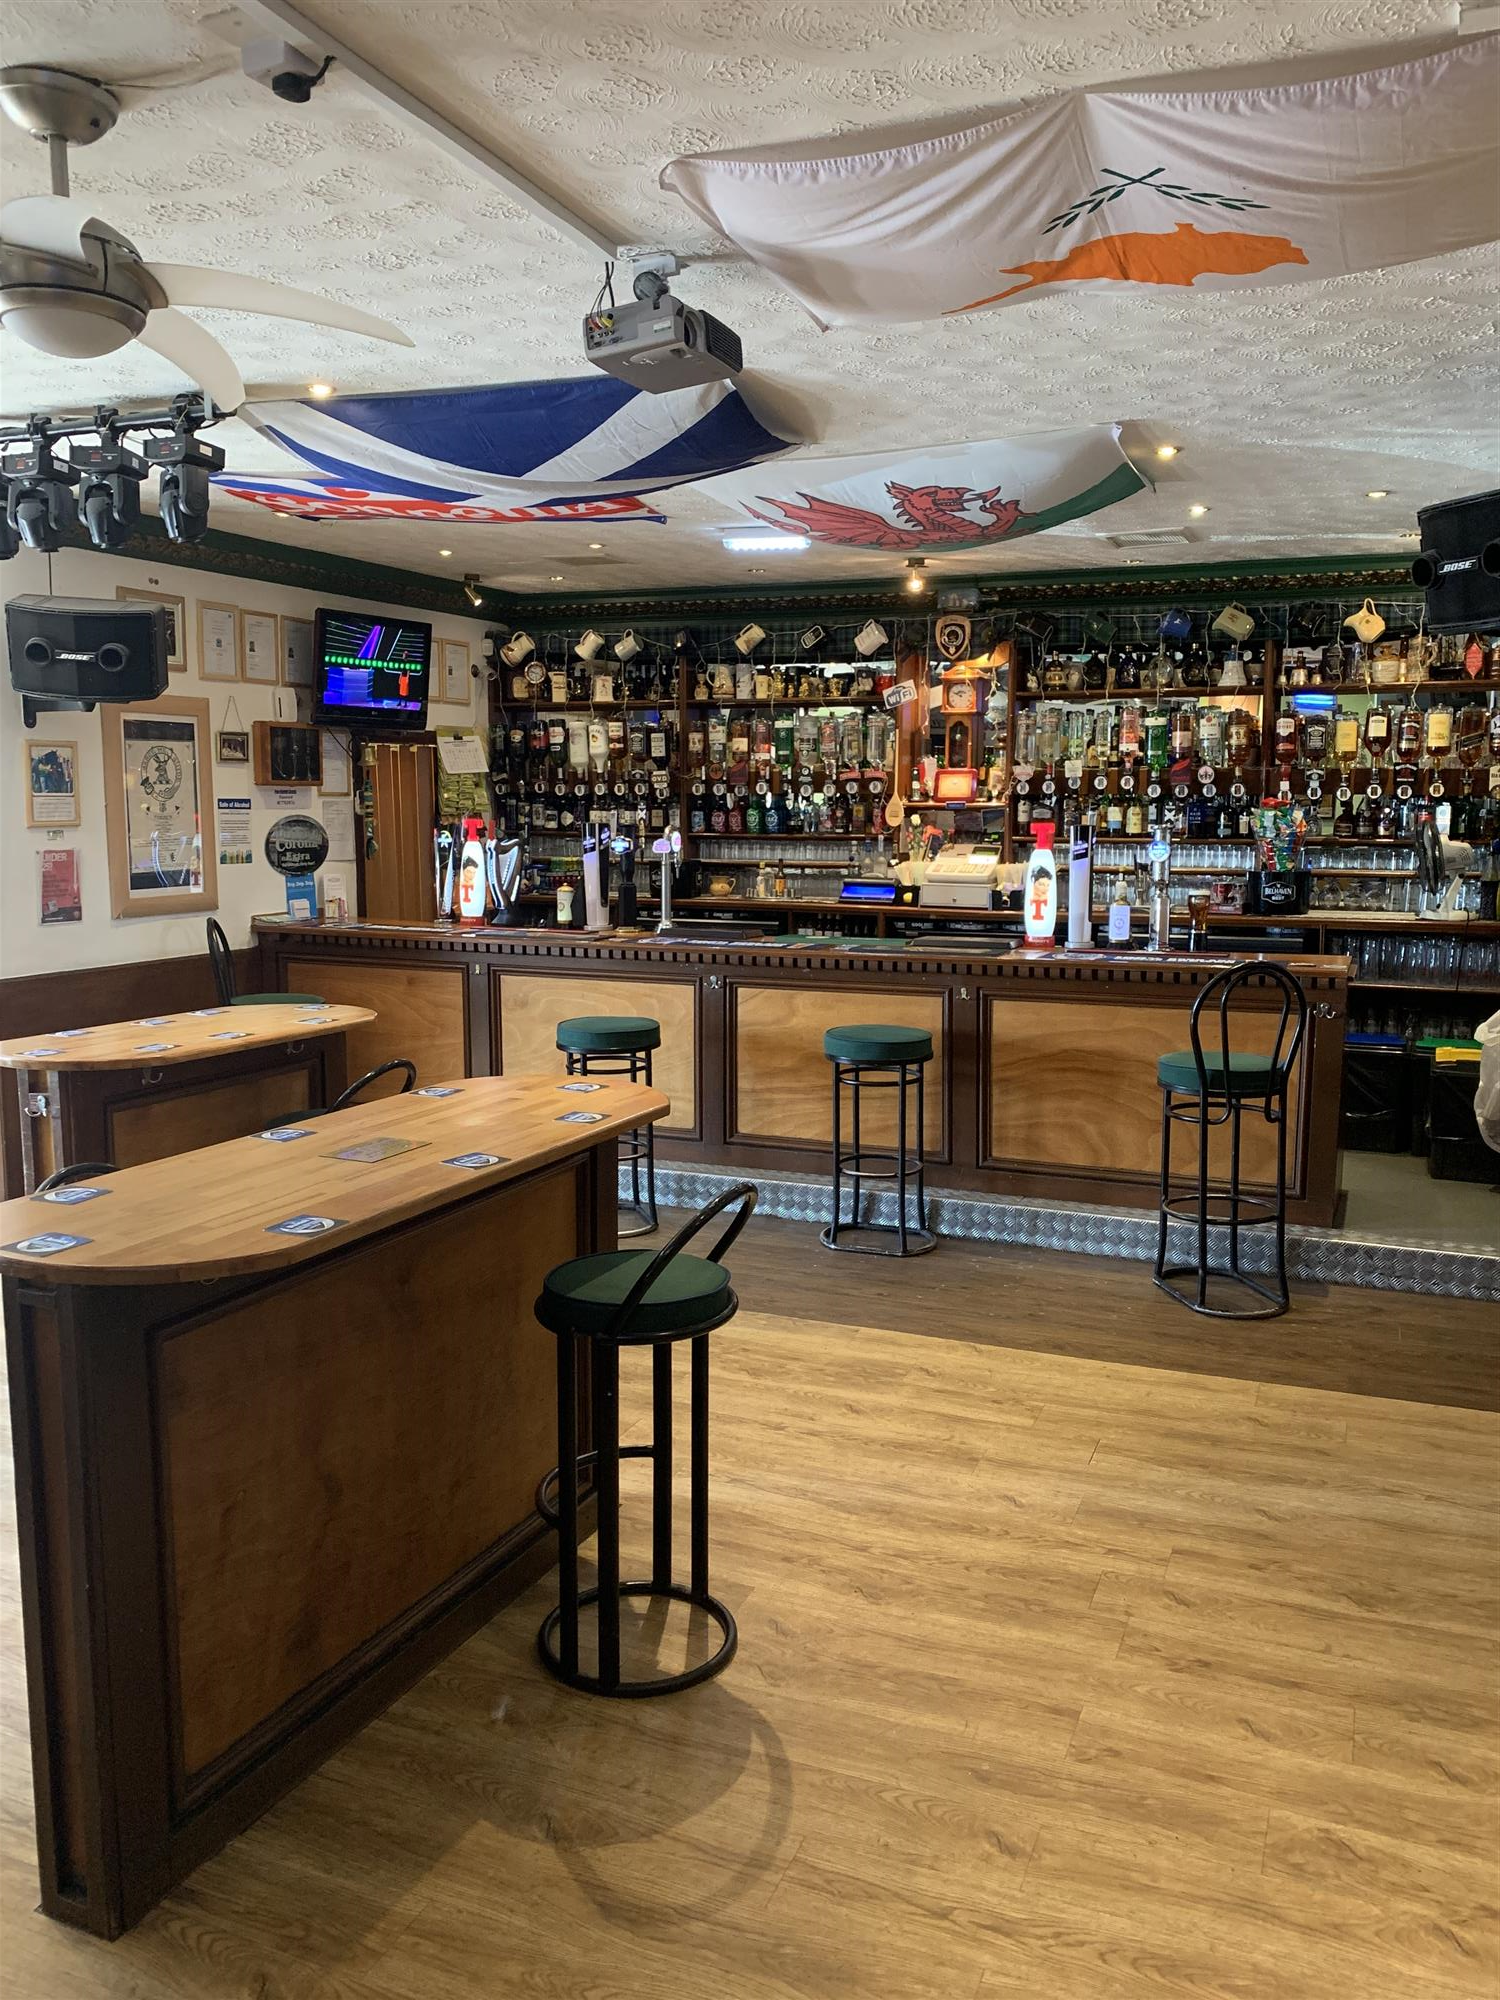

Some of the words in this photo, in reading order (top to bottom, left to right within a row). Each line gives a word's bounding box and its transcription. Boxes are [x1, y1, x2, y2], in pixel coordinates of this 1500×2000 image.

[1439, 559, 1477, 573] BOSE
[55, 653, 95, 661] BOSE
[461, 884, 474, 903] T
[1264, 887, 1293, 895] BELHAVEN
[1030, 900, 1048, 921] T
